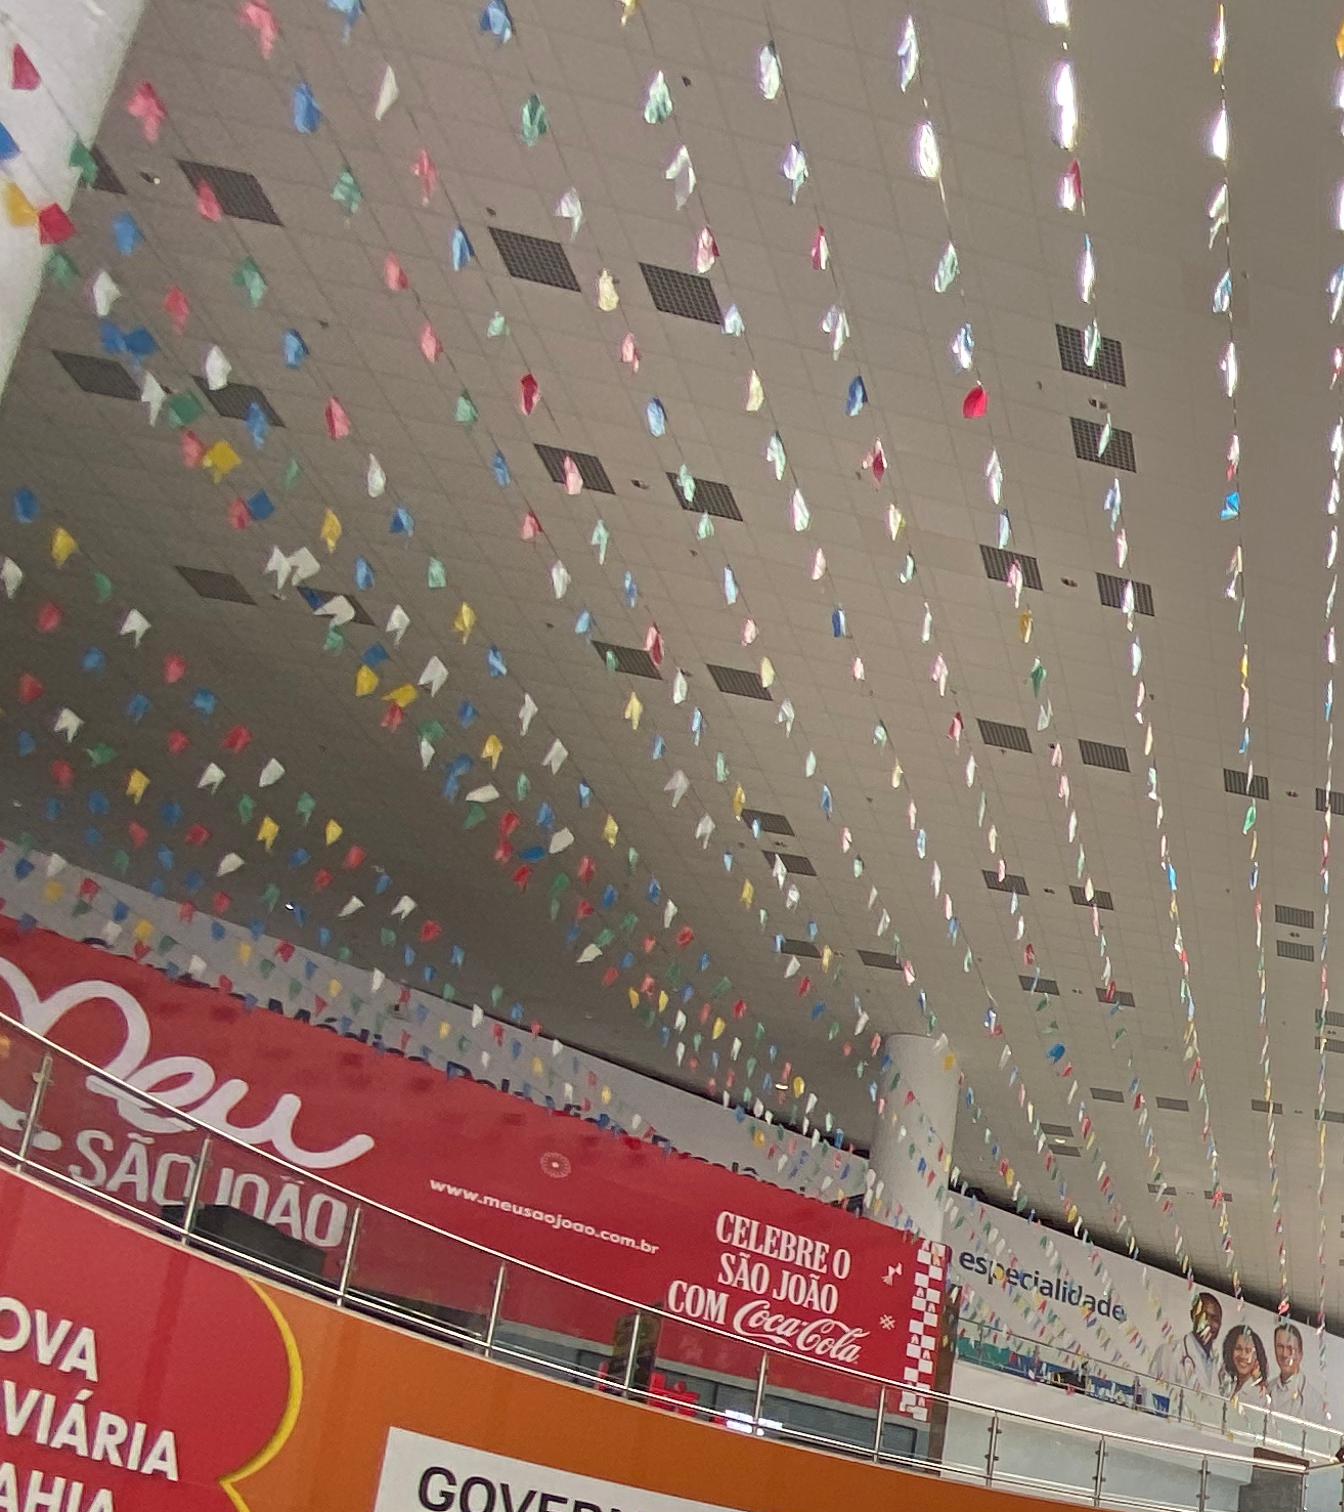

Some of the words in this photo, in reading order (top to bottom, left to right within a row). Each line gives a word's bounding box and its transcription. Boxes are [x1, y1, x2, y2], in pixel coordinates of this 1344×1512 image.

[69, 1130, 197, 1207] SÃO
[430, 1178, 660, 1257] www.meusaojoao.com.br
[716, 1211, 830, 1274] CELEBRE
[832, 1249, 851, 1279] O
[718, 1251, 770, 1294] SÃO
[772, 1269, 838, 1314] JOÃO
[959, 1247, 1127, 1322] especialidade
[668, 1280, 730, 1325] COM
[733, 1300, 870, 1363] Coca-Cola
